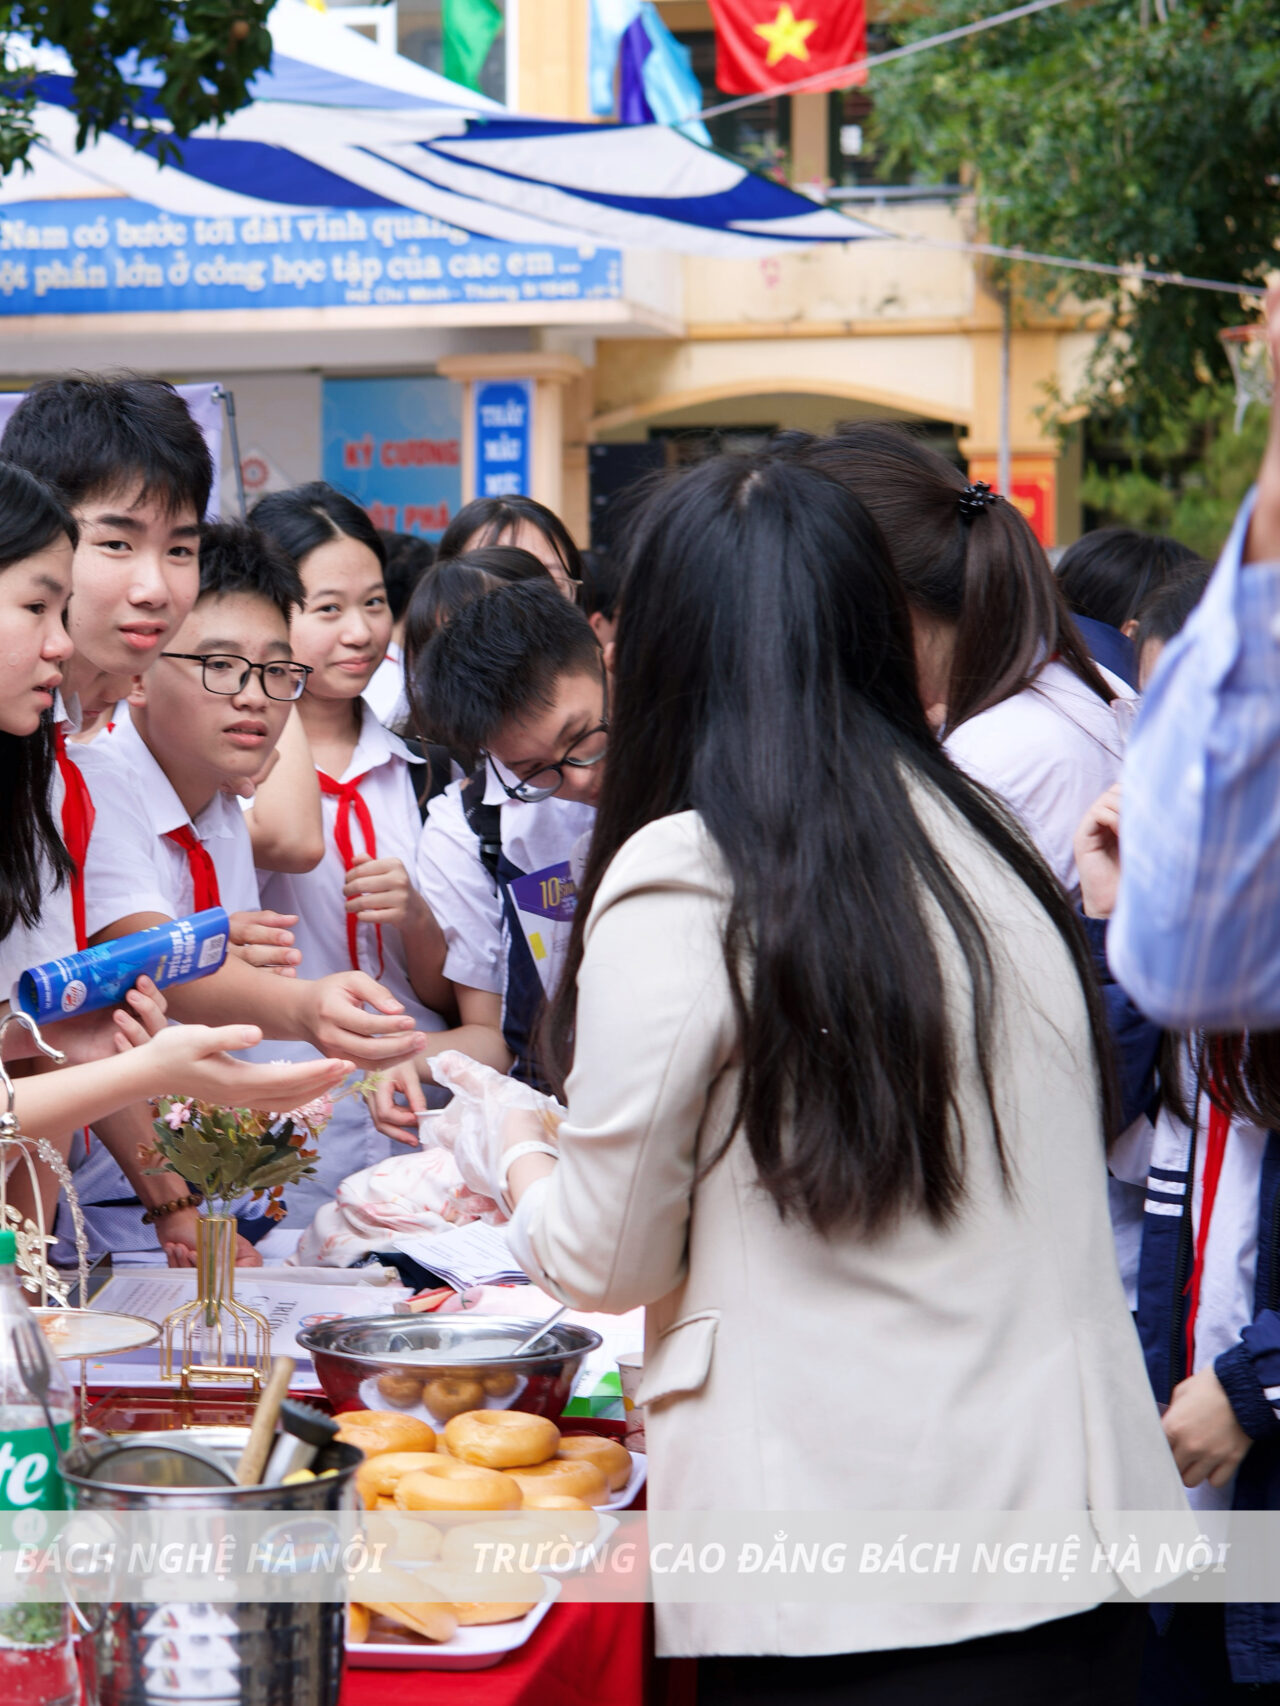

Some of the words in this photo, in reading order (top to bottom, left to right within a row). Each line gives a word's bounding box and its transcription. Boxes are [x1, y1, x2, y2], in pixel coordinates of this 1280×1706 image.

[0, 219, 68, 250] Nam
[73, 214, 110, 249] có
[272, 253, 326, 290] học
[539, 877, 560, 909] 10
